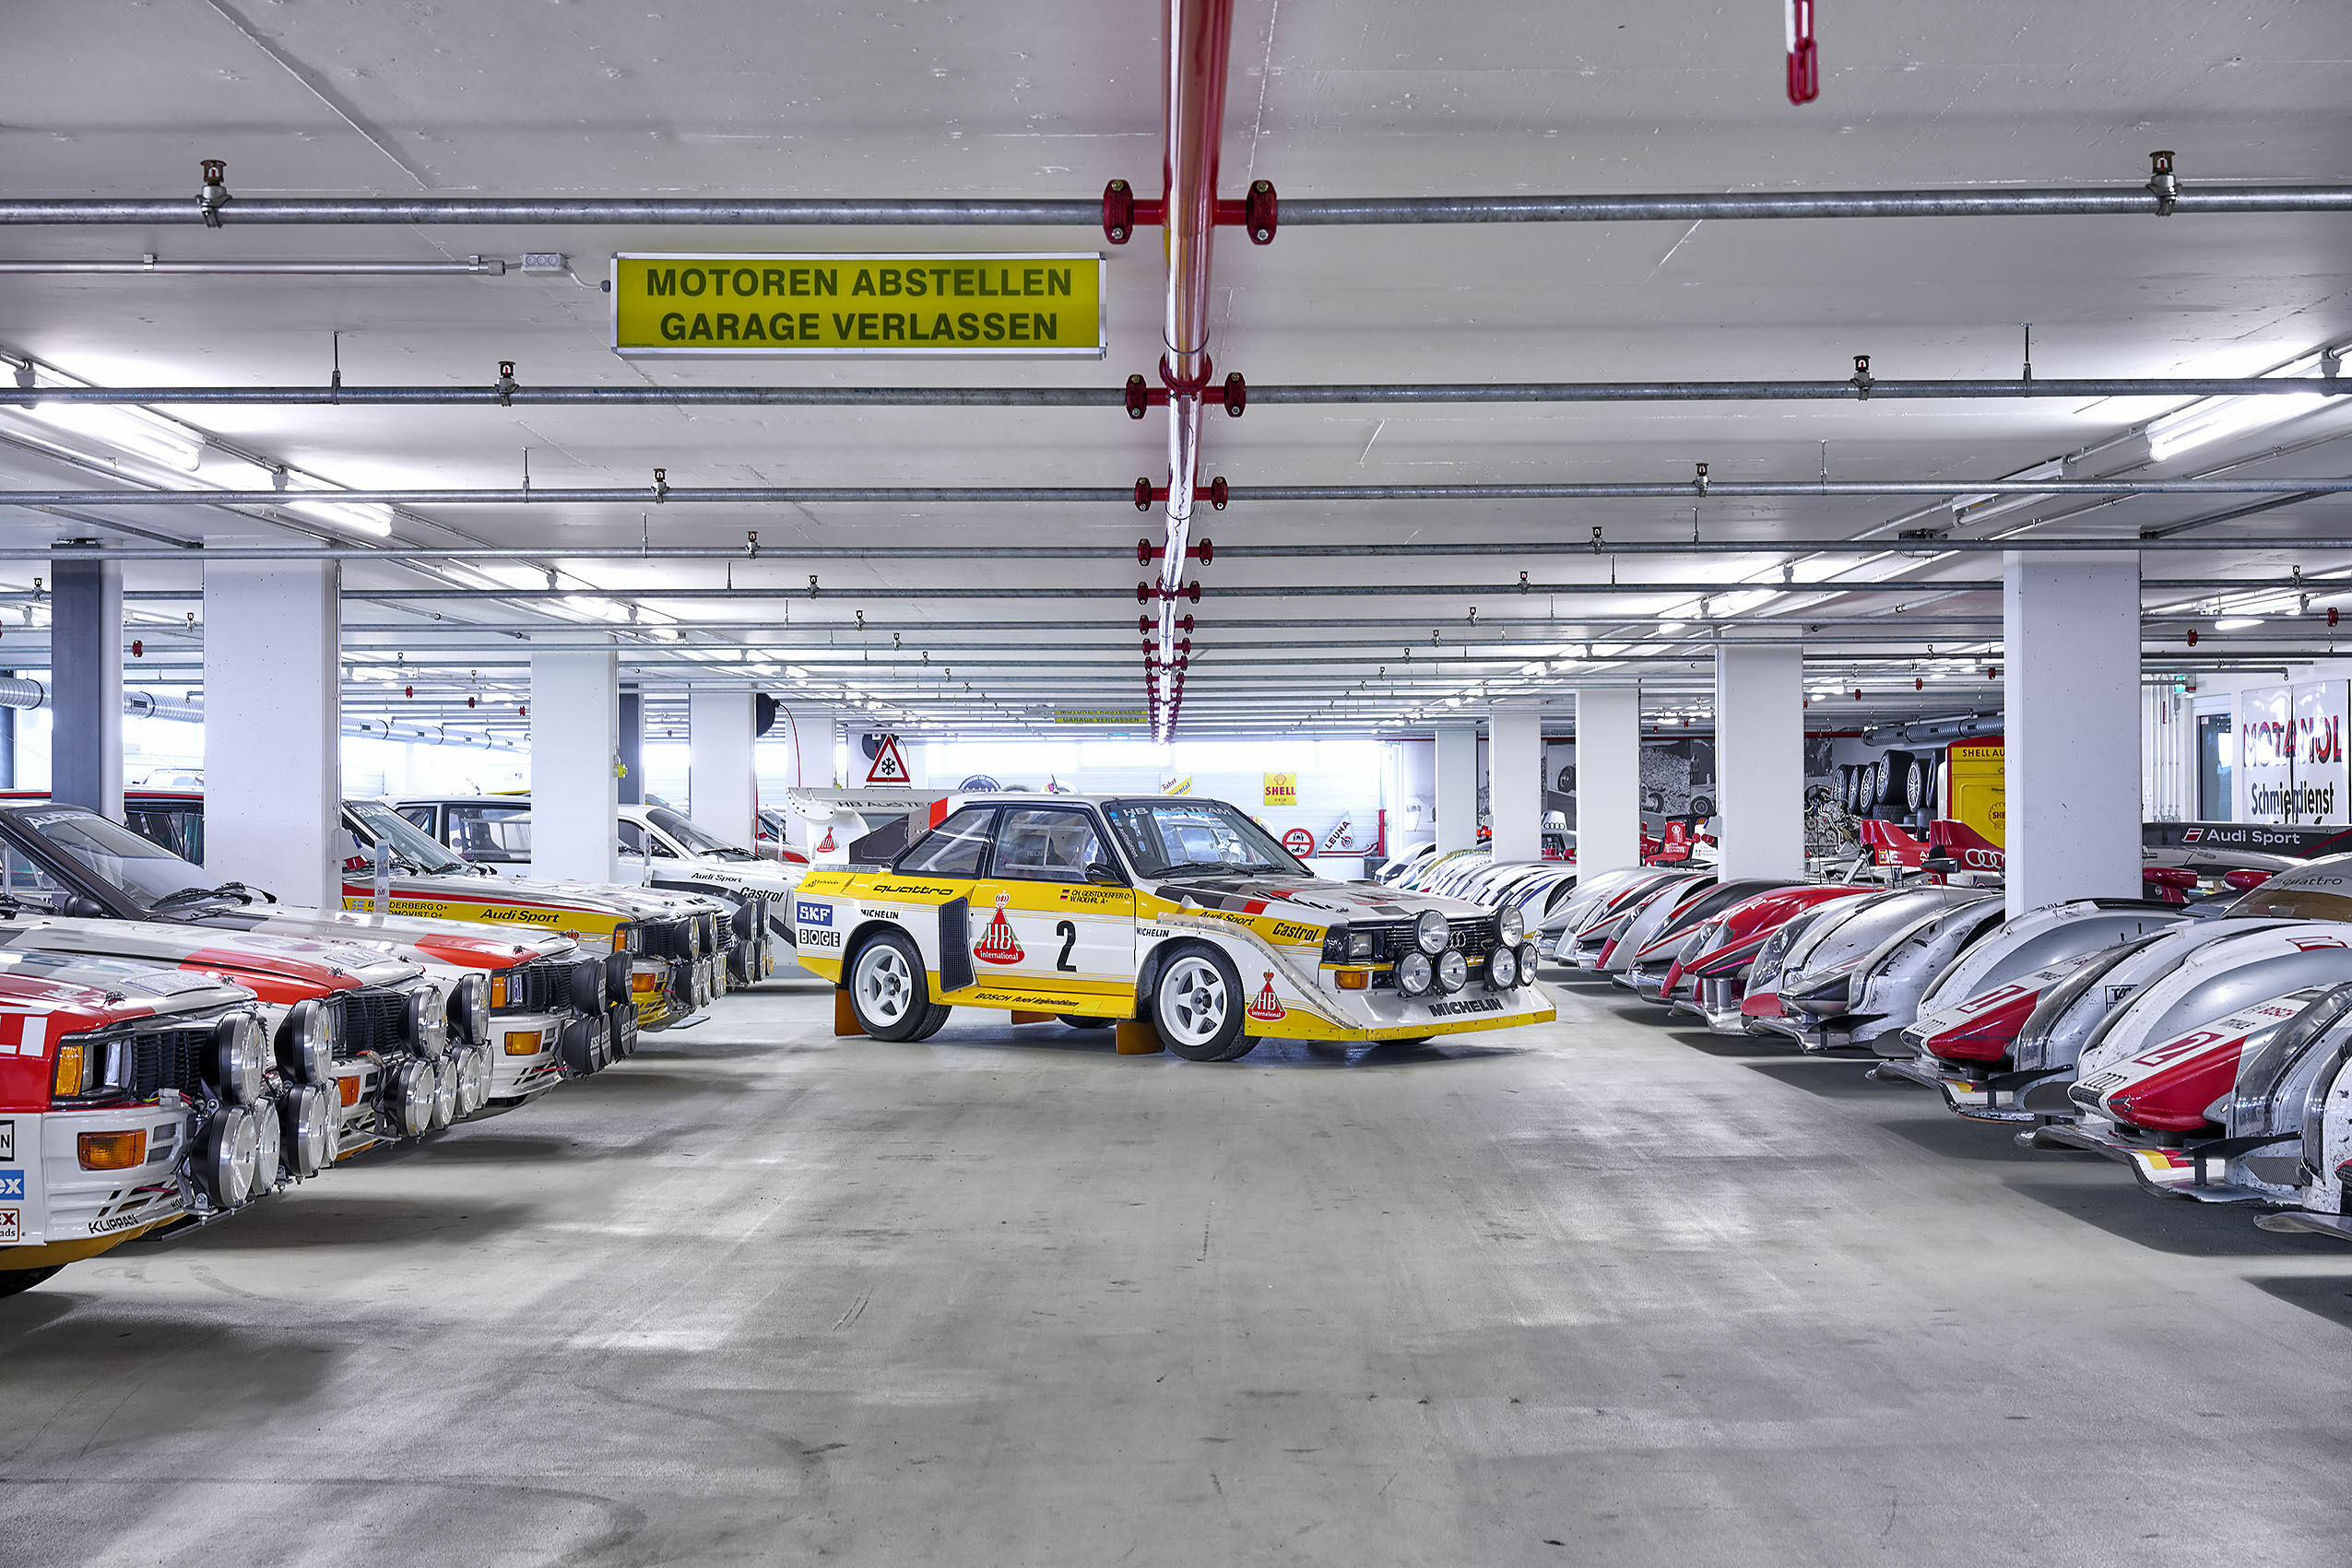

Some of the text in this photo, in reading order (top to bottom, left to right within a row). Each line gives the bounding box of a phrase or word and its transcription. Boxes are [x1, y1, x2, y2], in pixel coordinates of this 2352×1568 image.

[646, 268, 1072, 297] MOTOREN ABSTELLEN
[660, 312, 1058, 341] GARAGE VERLASSEN
[1962, 749, 1990, 757] SHELL
[1265, 786, 1296, 796] SHELL
[1123, 808, 1149, 818] HB
[1185, 806, 1232, 817] TEAM
[1325, 820, 1351, 849] LEUNA
[2206, 828, 2300, 846] Audi Sport
[691, 872, 742, 883] Audi Sport
[740, 887, 784, 903] Castrol
[873, 884, 954, 896] quattro
[480, 909, 560, 923] Audi Sport
[798, 905, 830, 922] SKF
[860, 909, 899, 920] MICHELIN
[799, 928, 841, 948] BOGE
[986, 923, 1012, 950] HB
[1136, 926, 1170, 937] MICHELIN
[1272, 922, 1319, 942] Castrol
[1056, 920, 1077, 973] 2
[980, 950, 1019, 961] international
[975, 993, 1012, 1001] BOSCH
[1257, 991, 1277, 1010] HB
[1428, 998, 1505, 1017] MICHELIN
[88, 1213, 140, 1234] KLIPPAN
